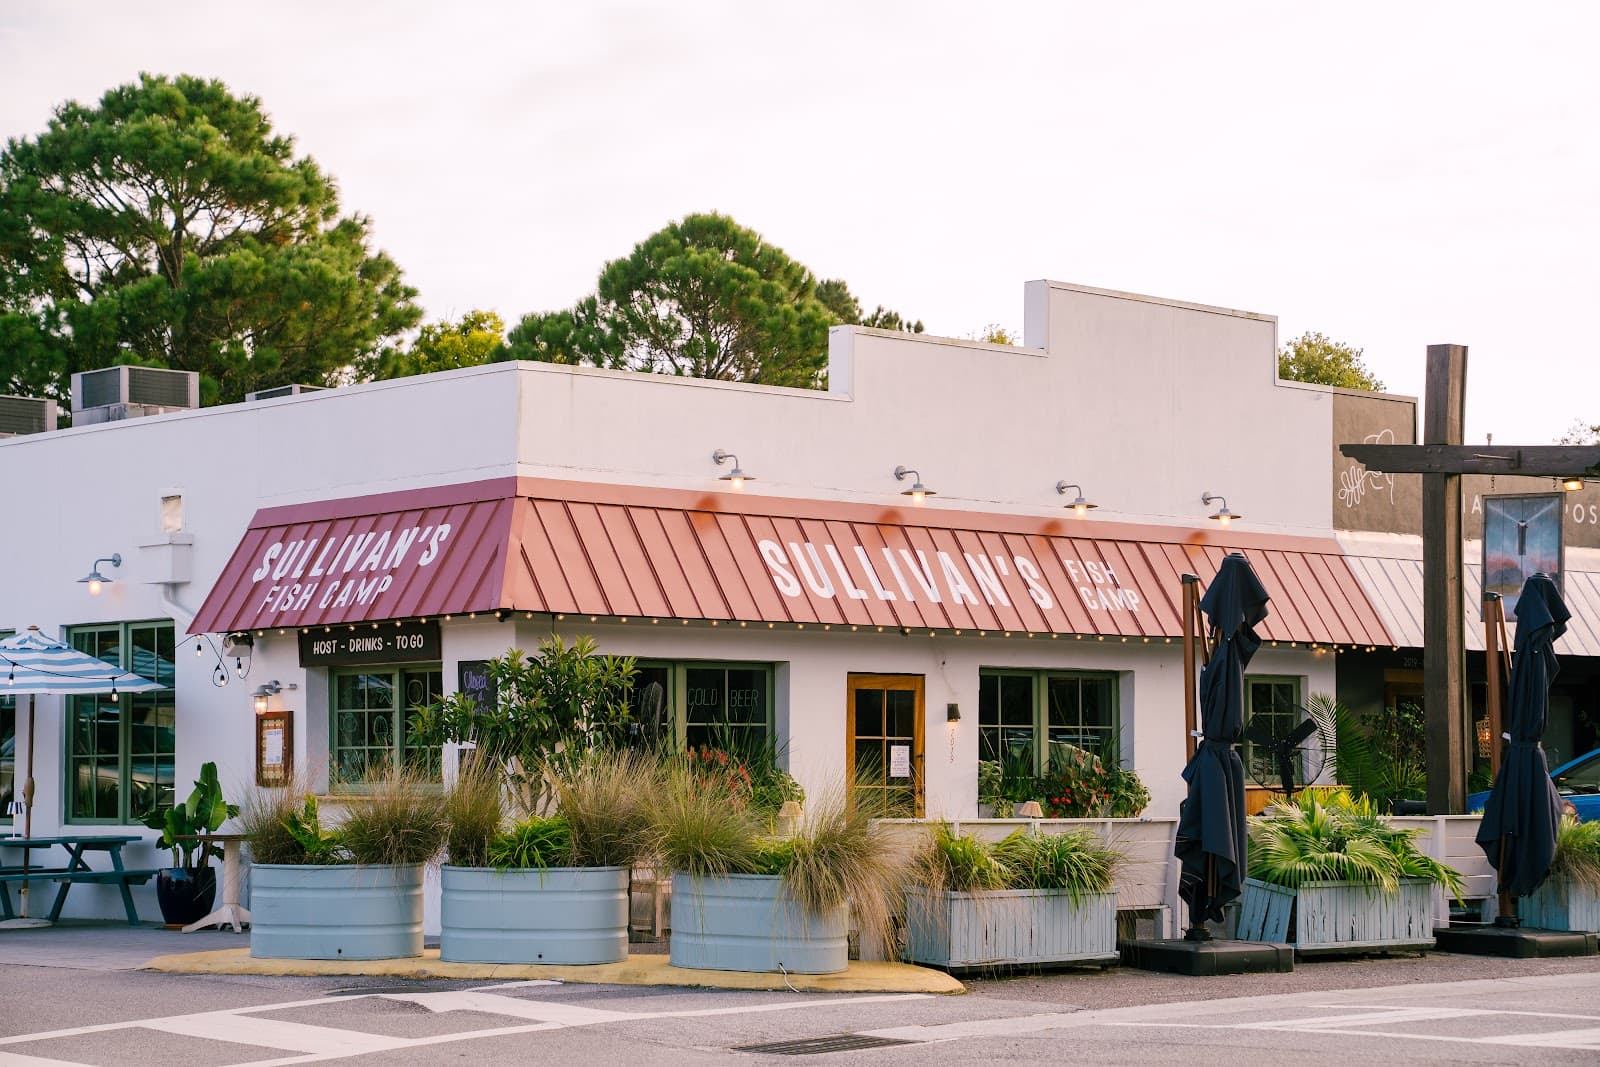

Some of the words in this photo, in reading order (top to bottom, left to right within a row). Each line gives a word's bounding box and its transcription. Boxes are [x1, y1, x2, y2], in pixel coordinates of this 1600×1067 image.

[253, 523, 451, 583] SULLIVAN'S
[758, 539, 1054, 610] SULLIVAN'S
[1064, 559, 1120, 585] FISH
[257, 582, 319, 614] FISH
[319, 574, 393, 610] CAMP
[1079, 586, 1140, 612] CAMP
[313, 640, 337, 655] HOST
[349, 637, 383, 653] DRINKS
[395, 635, 409, 650] TO
[409, 634, 424, 649] GO
[688, 687, 718, 706] COLD
[730, 689, 759, 707] BEER
